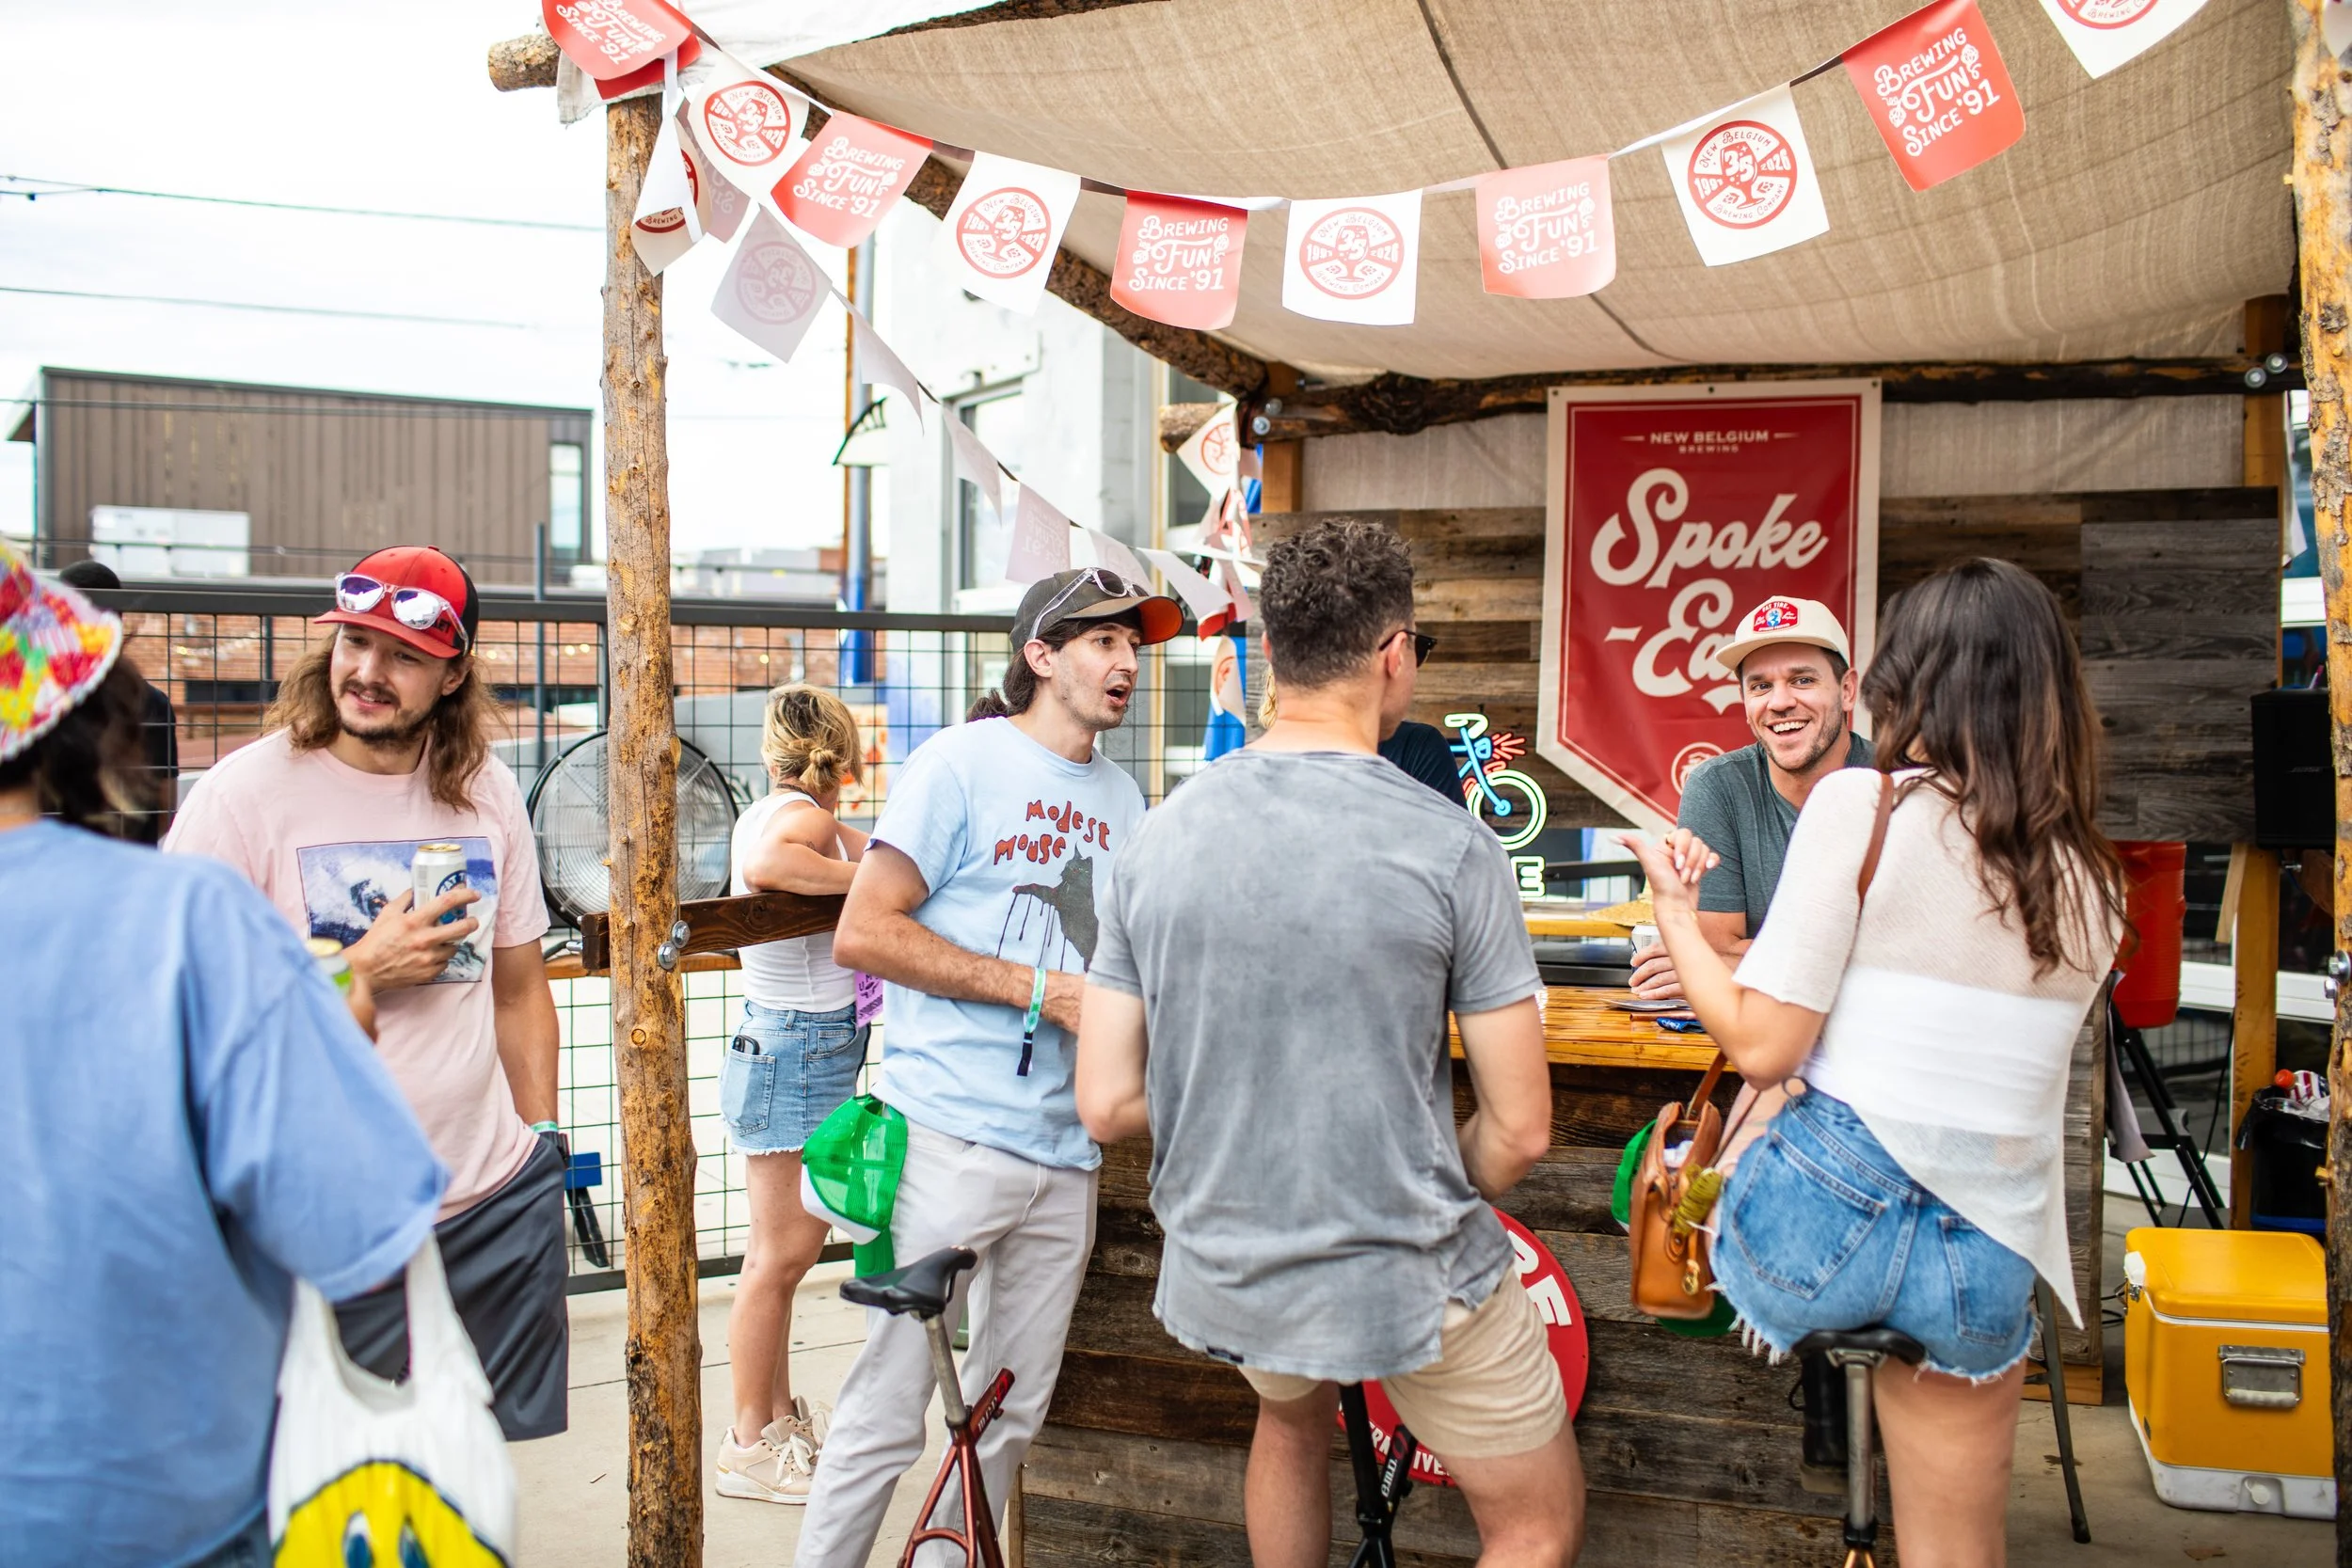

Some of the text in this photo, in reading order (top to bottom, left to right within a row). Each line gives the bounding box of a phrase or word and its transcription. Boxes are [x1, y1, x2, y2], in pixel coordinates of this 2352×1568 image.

[556, 5, 603, 43] SINCE
[584, 9, 644, 50] FUN
[1874, 27, 1966, 96] BREWING
[1901, 55, 1970, 122] FUN
[1699, 131, 1771, 167] NEW BELGIUM
[1902, 107, 1963, 156] SINCE
[824, 136, 906, 170] BREWING
[1724, 150, 1754, 182] 35
[1760, 148, 1791, 171] 2026
[793, 178, 849, 211] SINCE
[824, 160, 884, 196] FUN
[1494, 182, 1590, 222] BREWING
[1137, 215, 1229, 240] BREWING
[1513, 203, 1578, 252] FUN
[1151, 237, 1214, 274] FUN
[1498, 246, 1561, 274] SINCE
[1129, 267, 1188, 292] SINCE
[1650, 430, 1769, 444] NEW BELGIUM
[1678, 444, 1739, 454] BREWING
[1590, 467, 1829, 589] Spoke
